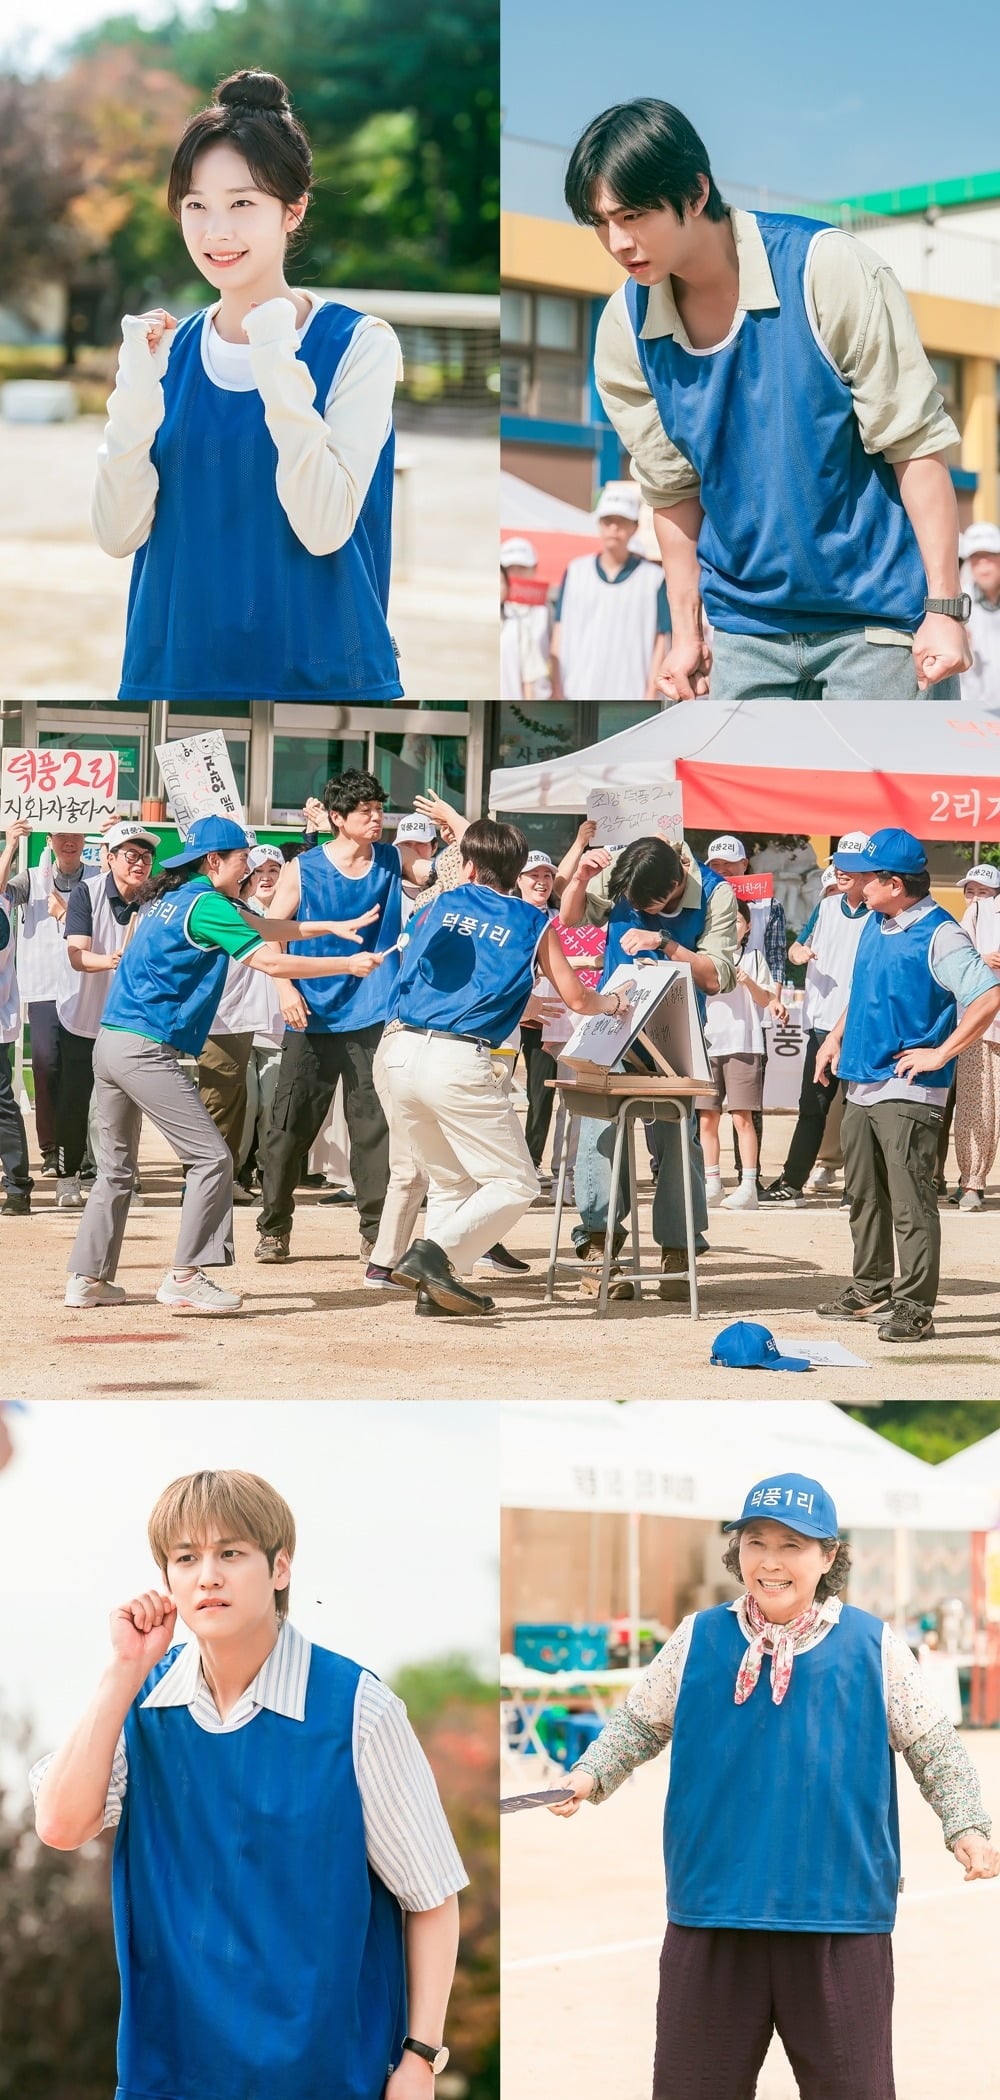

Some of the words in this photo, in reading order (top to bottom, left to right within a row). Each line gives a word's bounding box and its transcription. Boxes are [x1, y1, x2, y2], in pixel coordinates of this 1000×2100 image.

[7, 750, 116, 798] 덕풍2리
[399, 823, 427, 832] 덕풍2리
[442, 912, 511, 948] 덕풍1리
[750, 1487, 814, 1516] 덕풍1리
